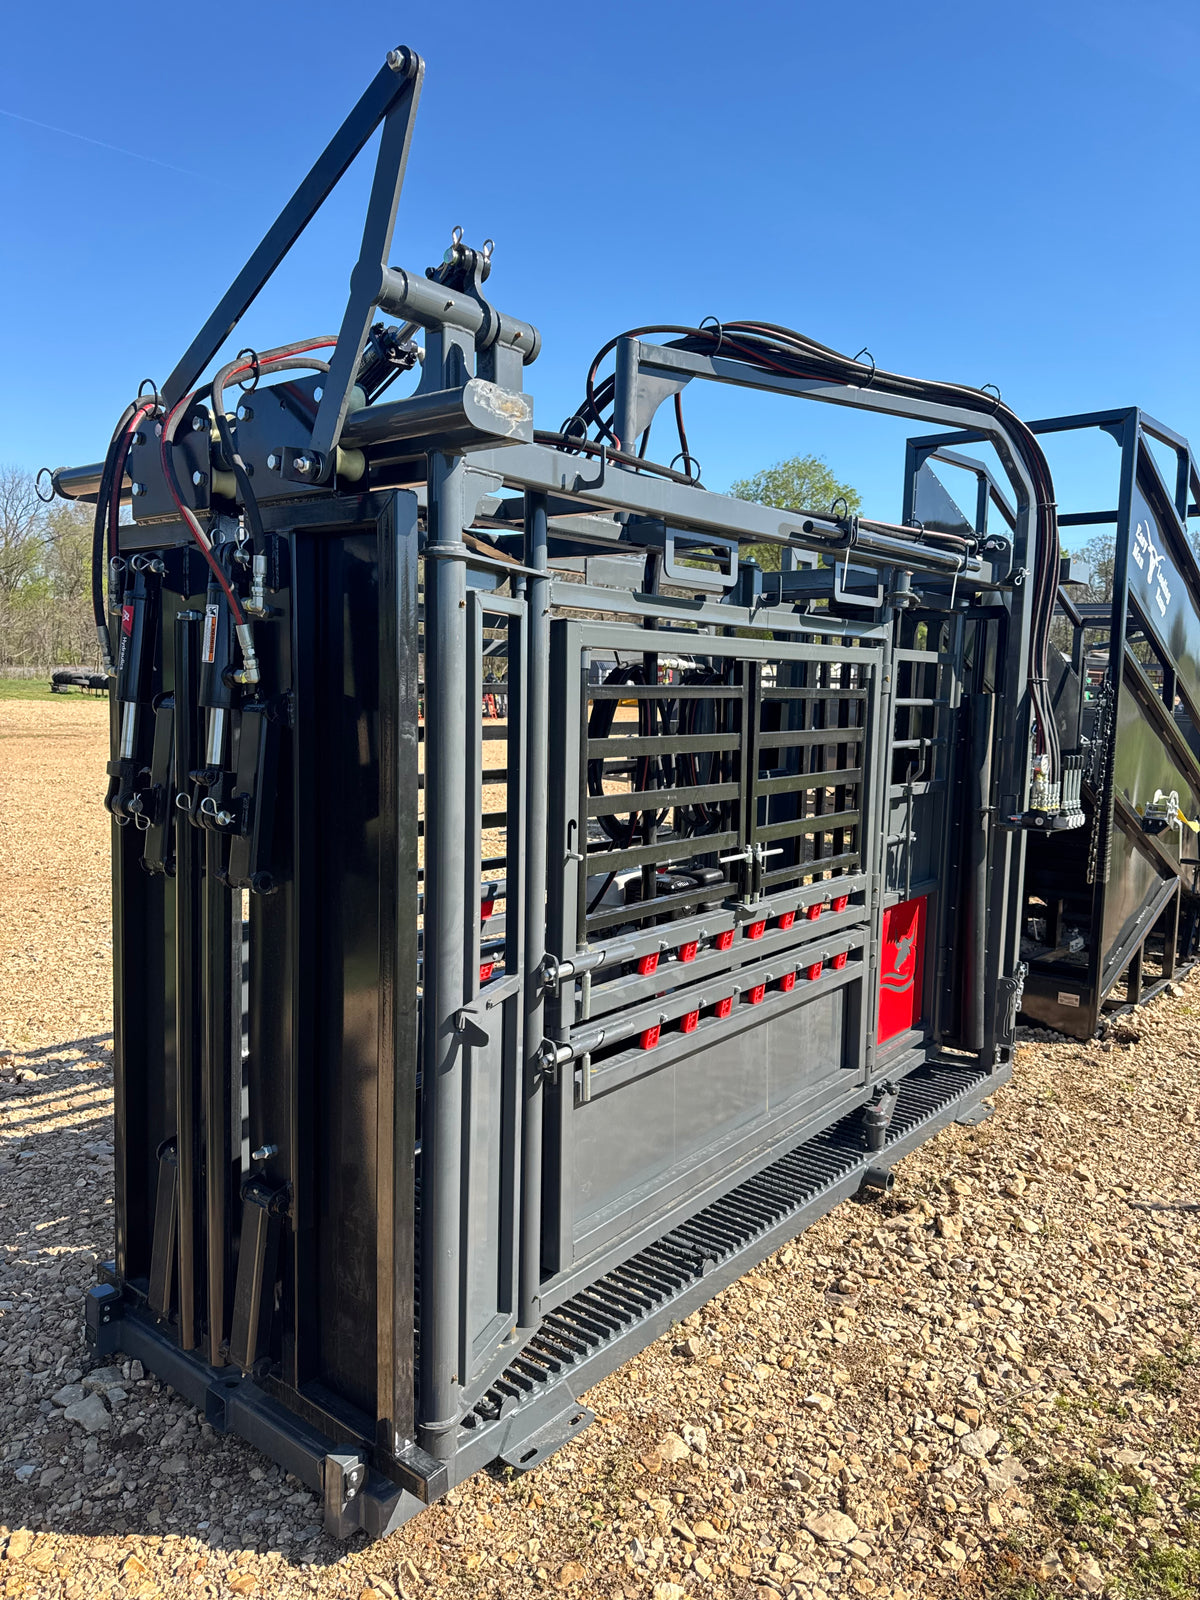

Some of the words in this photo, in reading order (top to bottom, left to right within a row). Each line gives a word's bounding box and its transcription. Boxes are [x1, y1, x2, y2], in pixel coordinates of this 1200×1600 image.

[1135, 523, 1148, 554] Easy
[1157, 564, 1171, 605] Loading
[119, 636, 127, 670] Hydraulics
